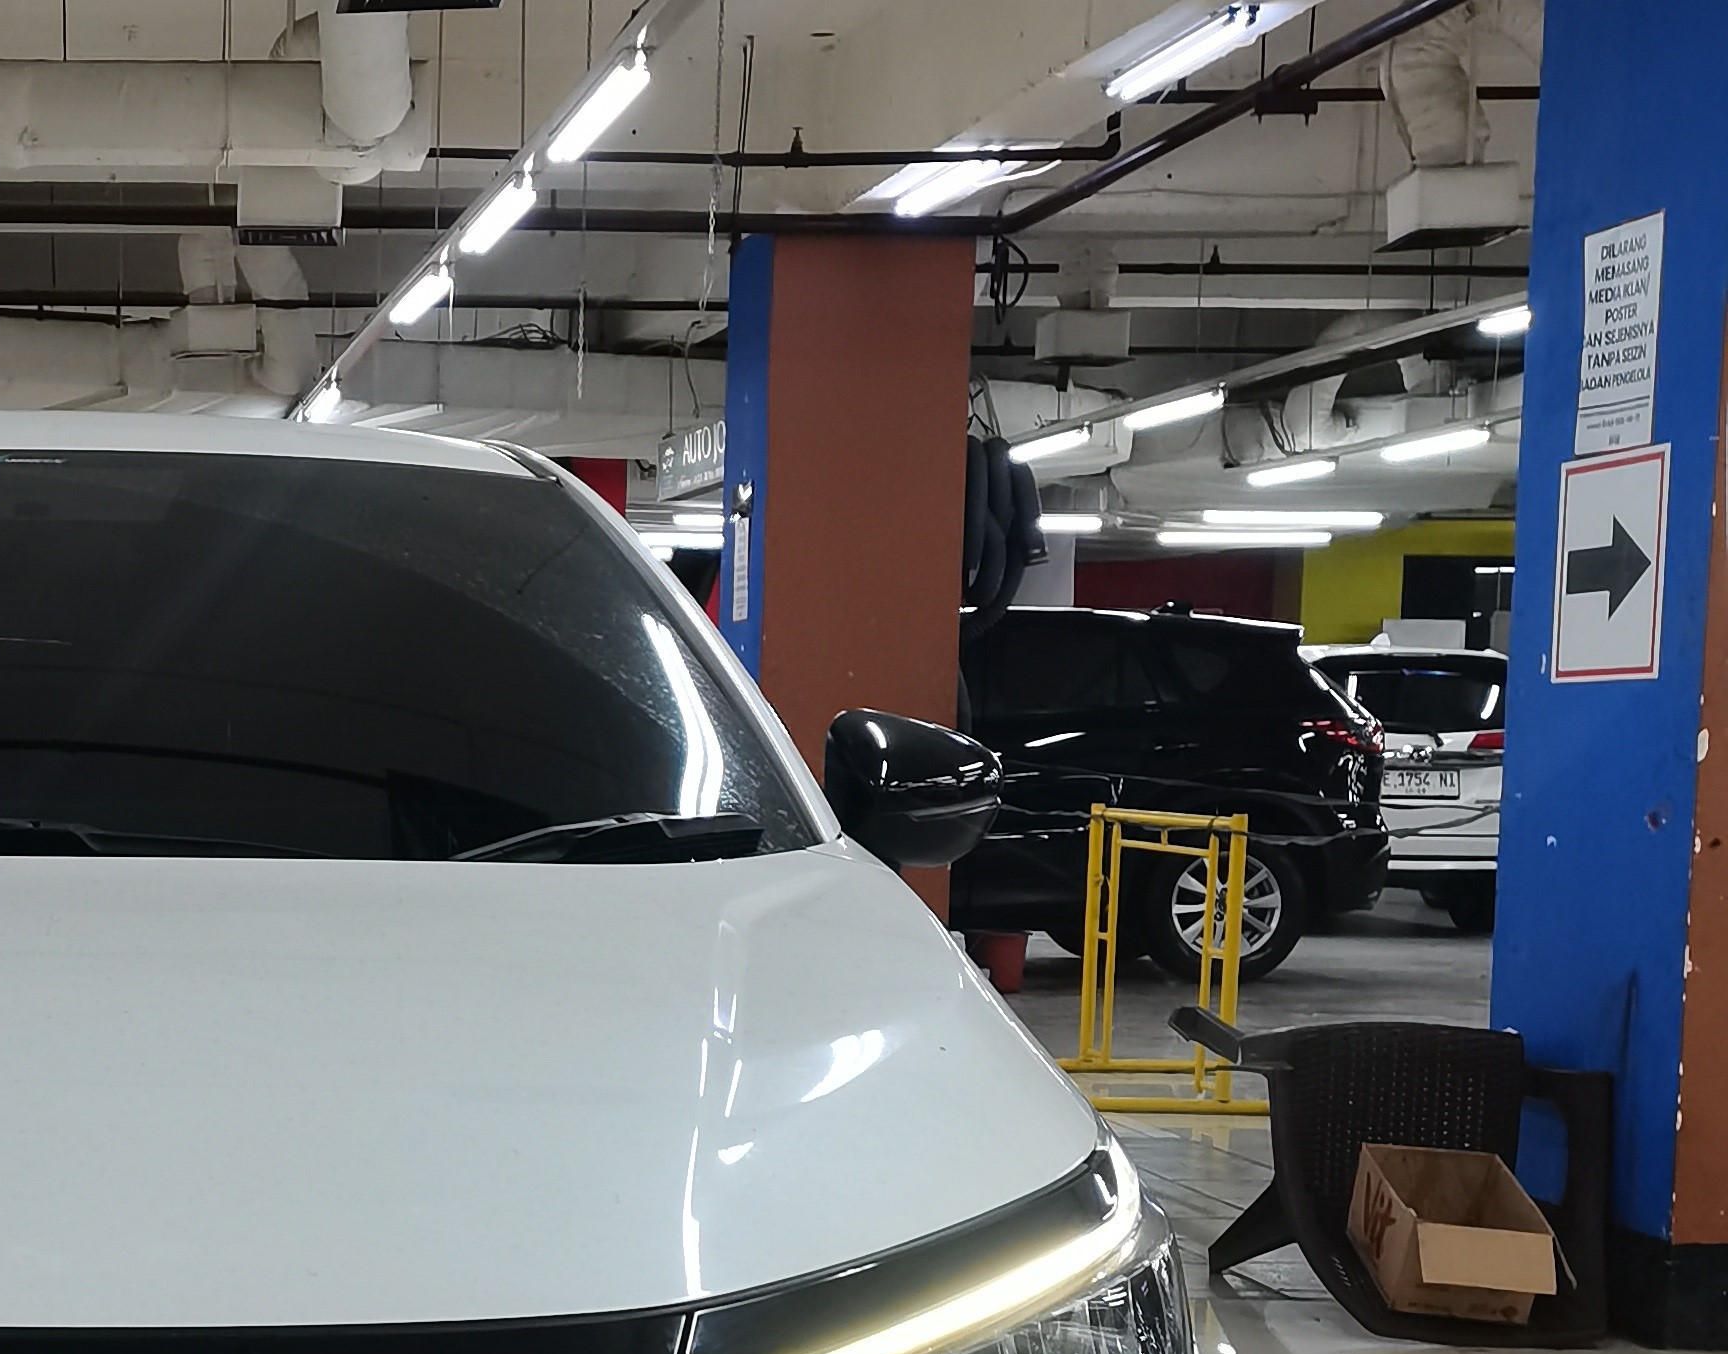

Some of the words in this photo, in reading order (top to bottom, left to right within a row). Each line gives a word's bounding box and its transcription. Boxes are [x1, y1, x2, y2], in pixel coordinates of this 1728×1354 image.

[1600, 232, 1648, 262] DILARANG
[1593, 255, 1650, 285] MEMASANG
[1588, 286, 1622, 306] MEDIA
[1604, 302, 1638, 326] POSTER
[1583, 330, 1603, 349] AN
[1587, 349, 1621, 370] TANPA
[682, 426, 712, 467] AUTO
